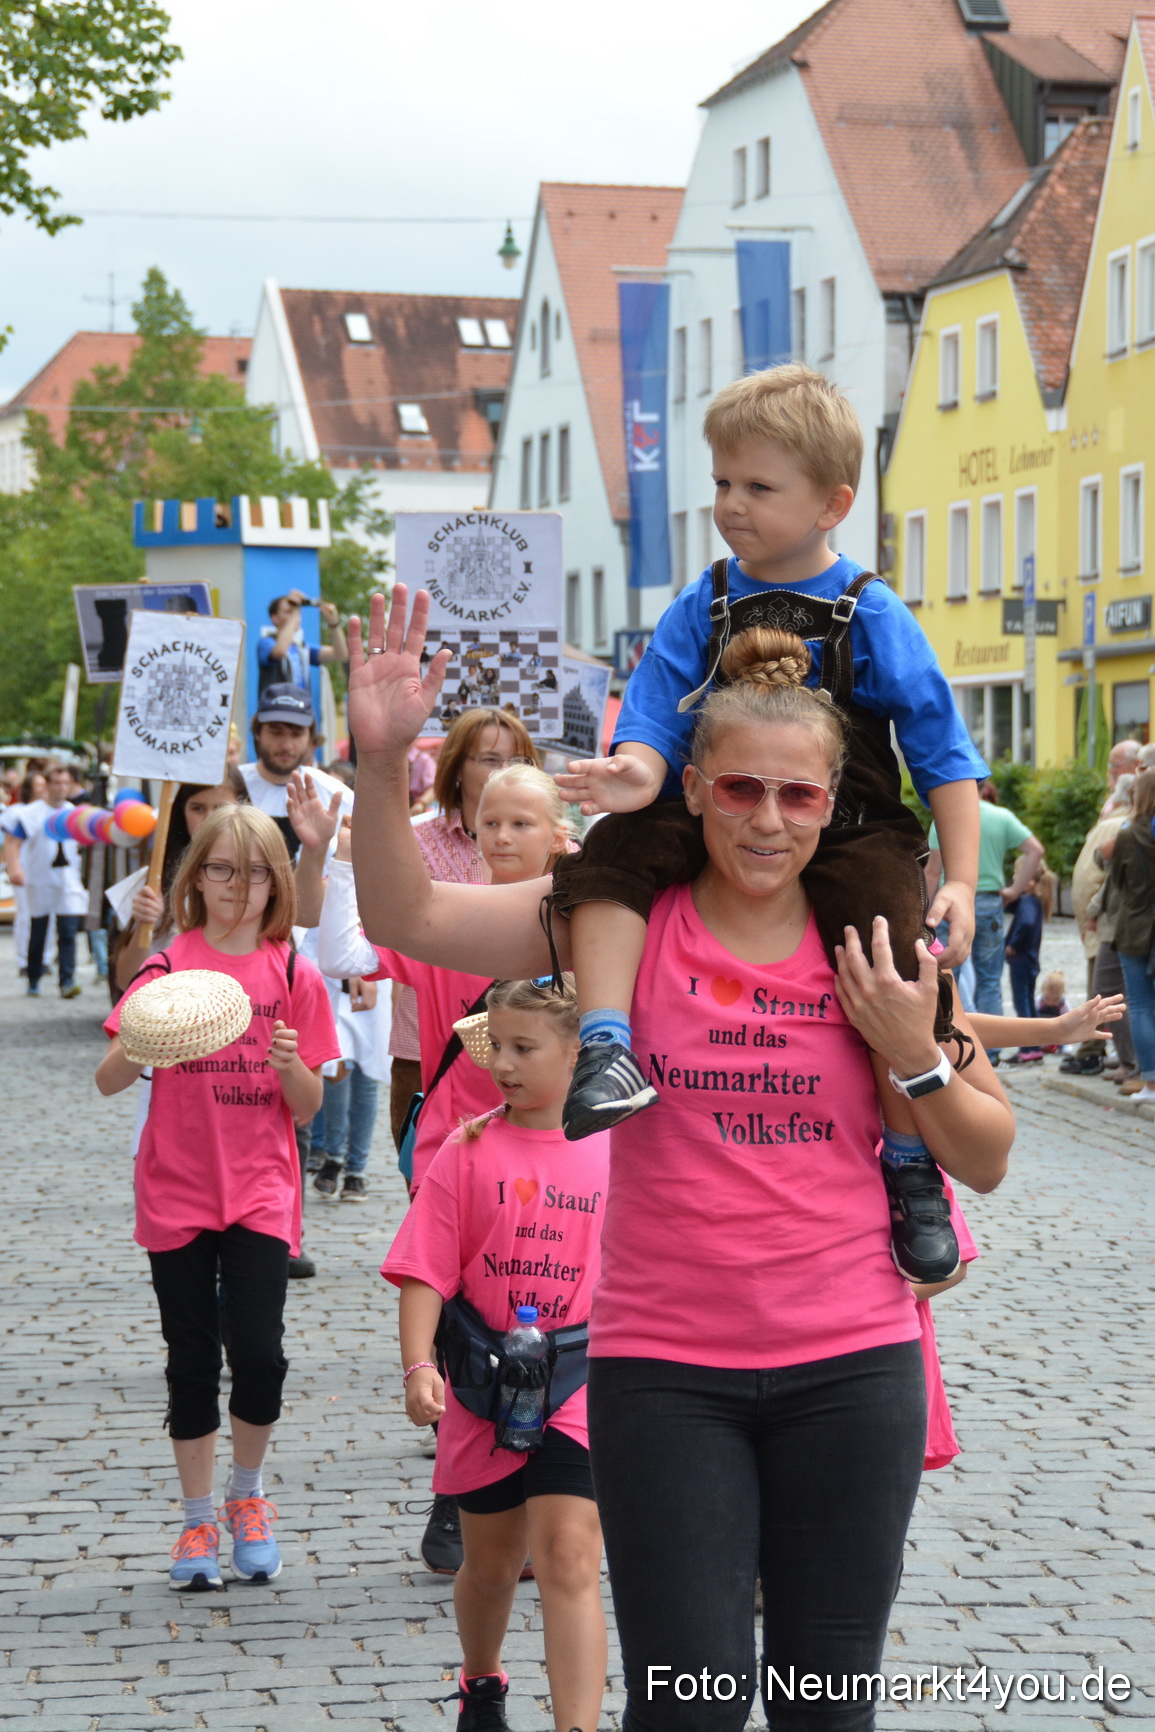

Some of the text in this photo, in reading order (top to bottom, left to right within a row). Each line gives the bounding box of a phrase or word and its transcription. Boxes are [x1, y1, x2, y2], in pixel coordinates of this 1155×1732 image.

[959, 448, 998, 488] HOTEL
[428, 514, 528, 553] SCHACHKLUB
[425, 578, 512, 622] NEUMARKT
[1103, 600, 1143, 628] TAIFUN
[1004, 620, 1056, 633] TAUN
[131, 641, 228, 683] SCHACHKLUB
[954, 640, 1010, 667] Restaurant
[124, 705, 203, 754] NEUMARKT
[687, 976, 832, 1019] I Stauf
[708, 1024, 787, 1048] und das
[175, 1053, 268, 1074] Neumarkter
[649, 1053, 821, 1095] Neumarkter
[712, 1112, 836, 1145] Volksfest
[497, 1181, 601, 1214] I Stauf
[540, 1224, 564, 1242] das
